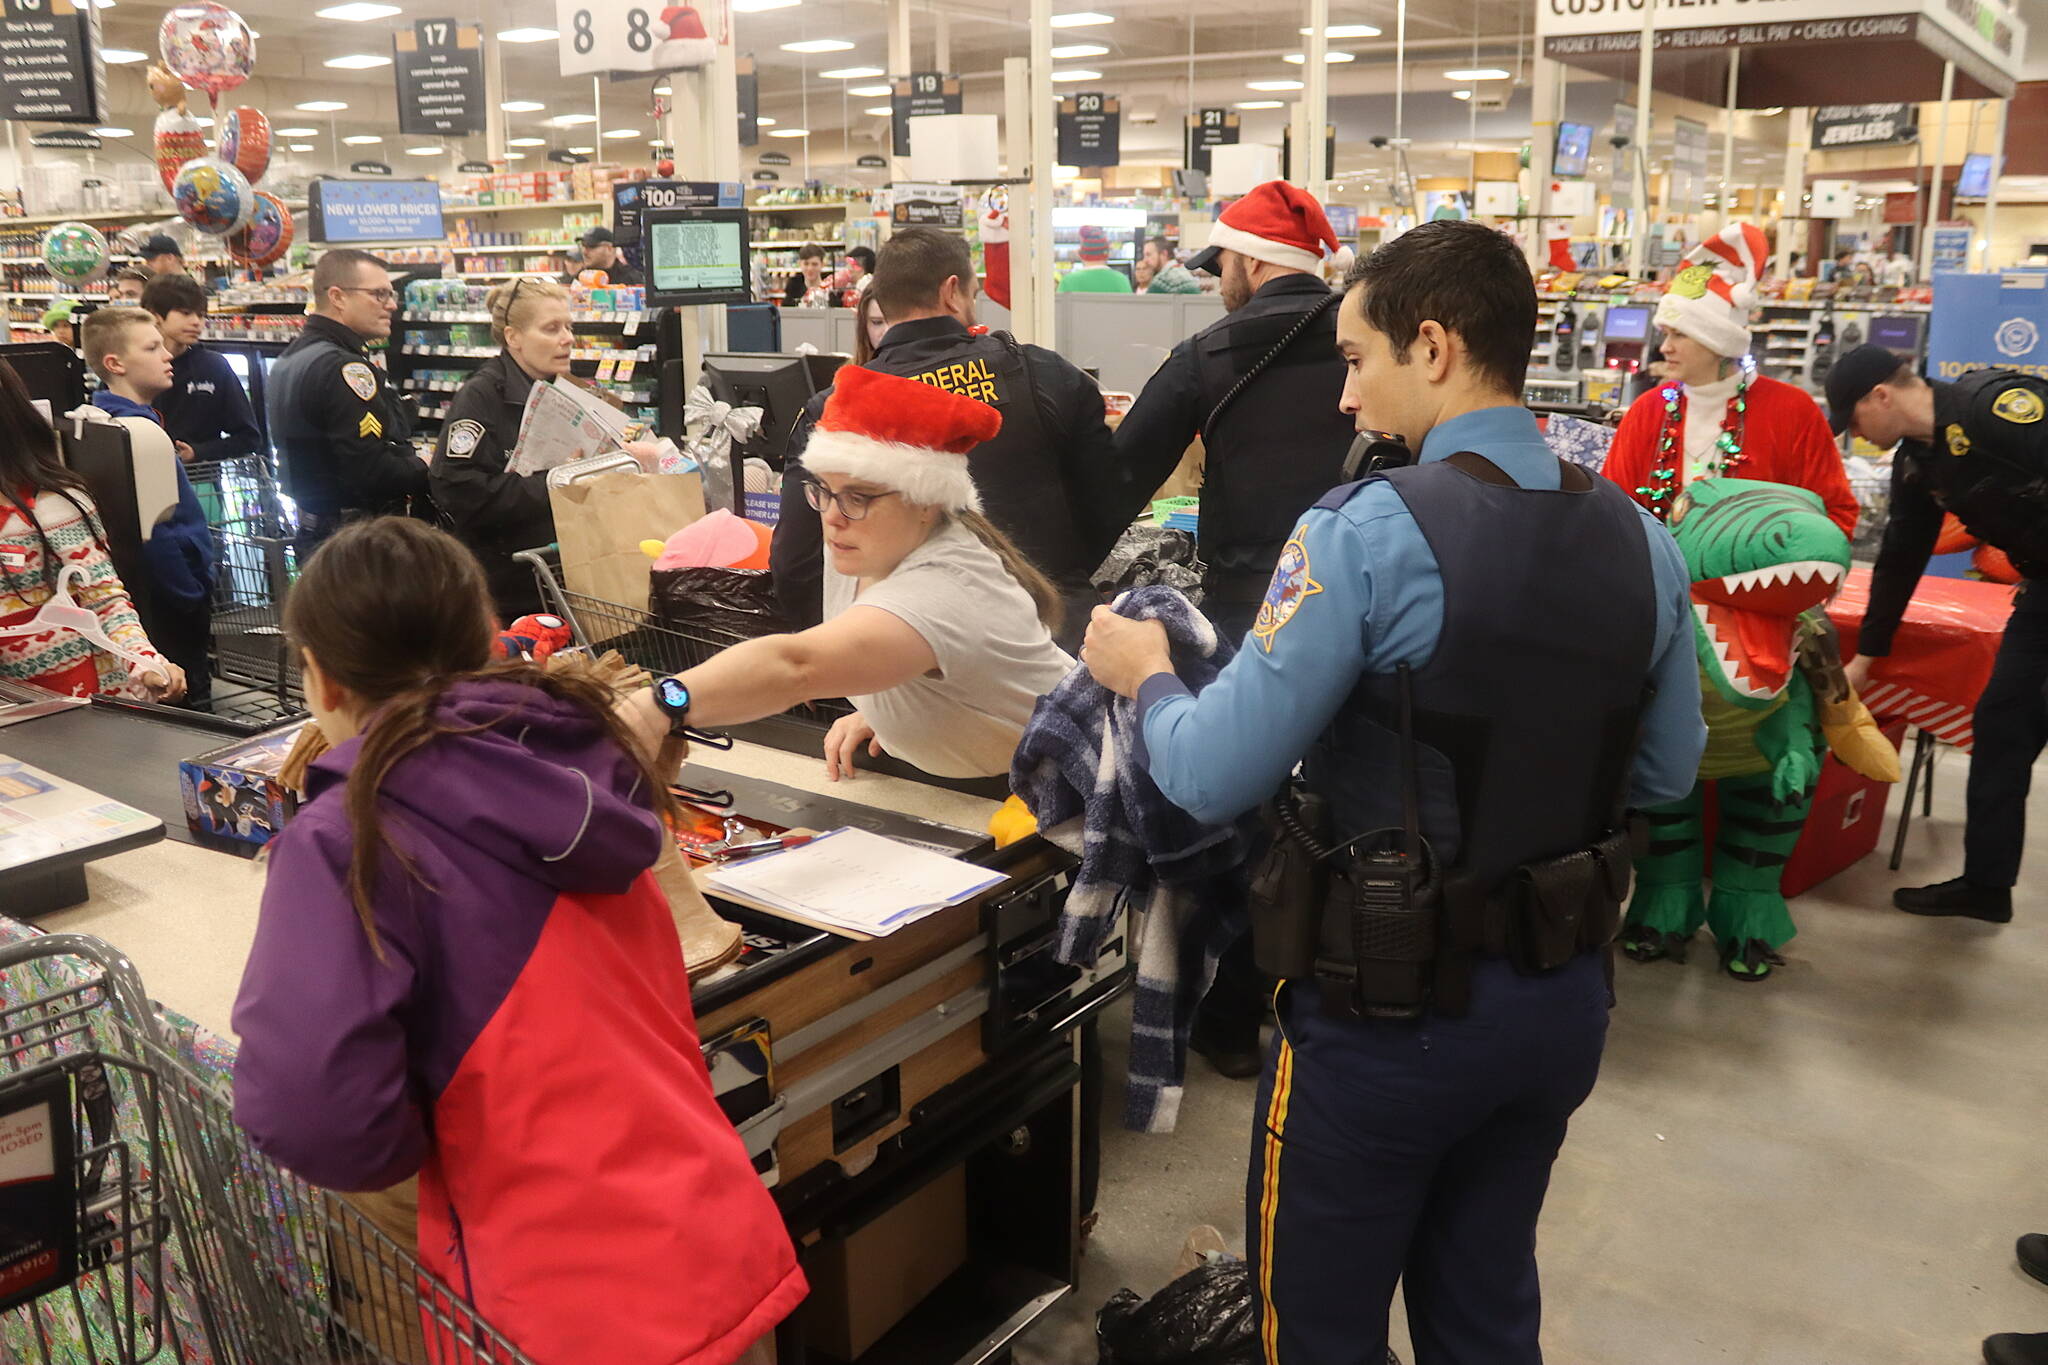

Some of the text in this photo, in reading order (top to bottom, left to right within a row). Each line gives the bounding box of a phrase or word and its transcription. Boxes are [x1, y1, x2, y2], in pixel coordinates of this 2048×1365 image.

[424, 24, 447, 46] 17
[574, 8, 652, 54] 8 8
[1737, 24, 1793, 43] BILL PAY
[1803, 17, 1909, 40] CHECK CASHING
[1555, 32, 1662, 53] MONEY TRANSFS
[1671, 29, 1727, 47] RETURNS
[918, 76, 936, 92] 19
[1079, 96, 1099, 111] 20
[1204, 111, 1221, 125] 21
[1821, 120, 1895, 145] JEWELERS
[641, 189, 676, 207] $100
[326, 203, 438, 216] NEW LOWER PRICES
[907, 358, 996, 390] DERAL
[745, 510, 767, 518] OTHER
